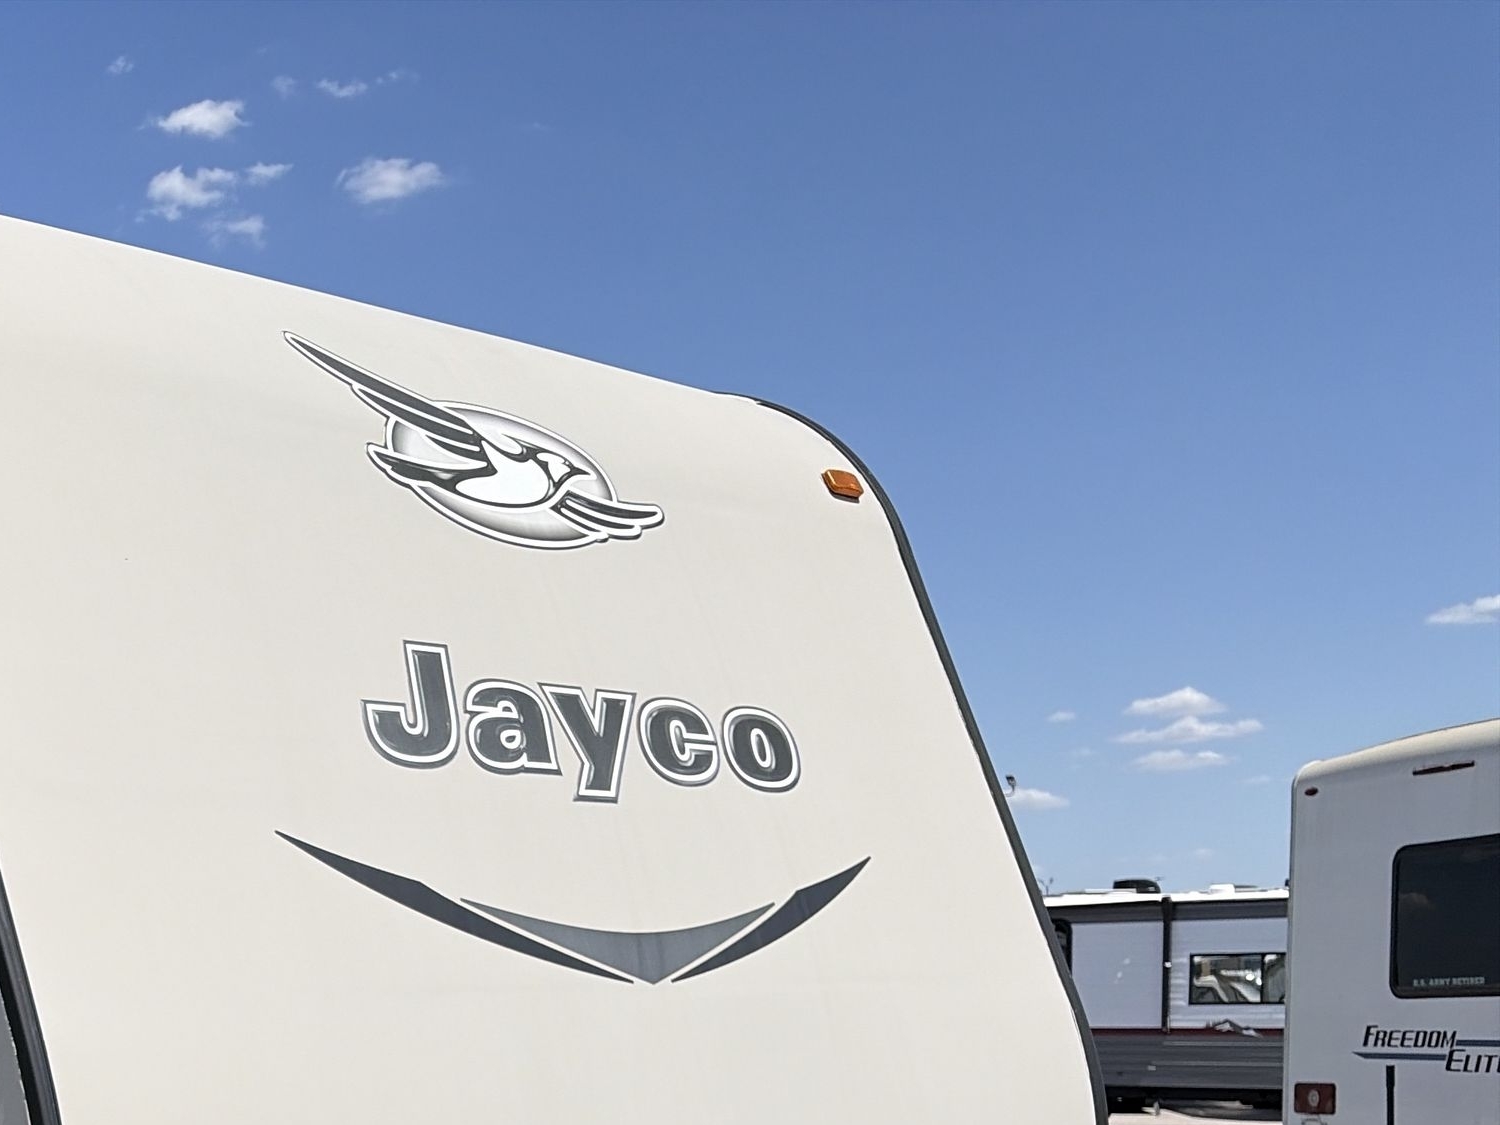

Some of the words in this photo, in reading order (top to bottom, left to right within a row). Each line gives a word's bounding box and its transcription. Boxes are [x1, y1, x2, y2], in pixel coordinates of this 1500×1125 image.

[360, 639, 801, 804] Jayco
[1428, 977, 1451, 986] ARMY
[1452, 976, 1485, 985] RETIRED
[1362, 1024, 1457, 1048] FREEDOM
[1445, 1049, 1500, 1073] ELIT
